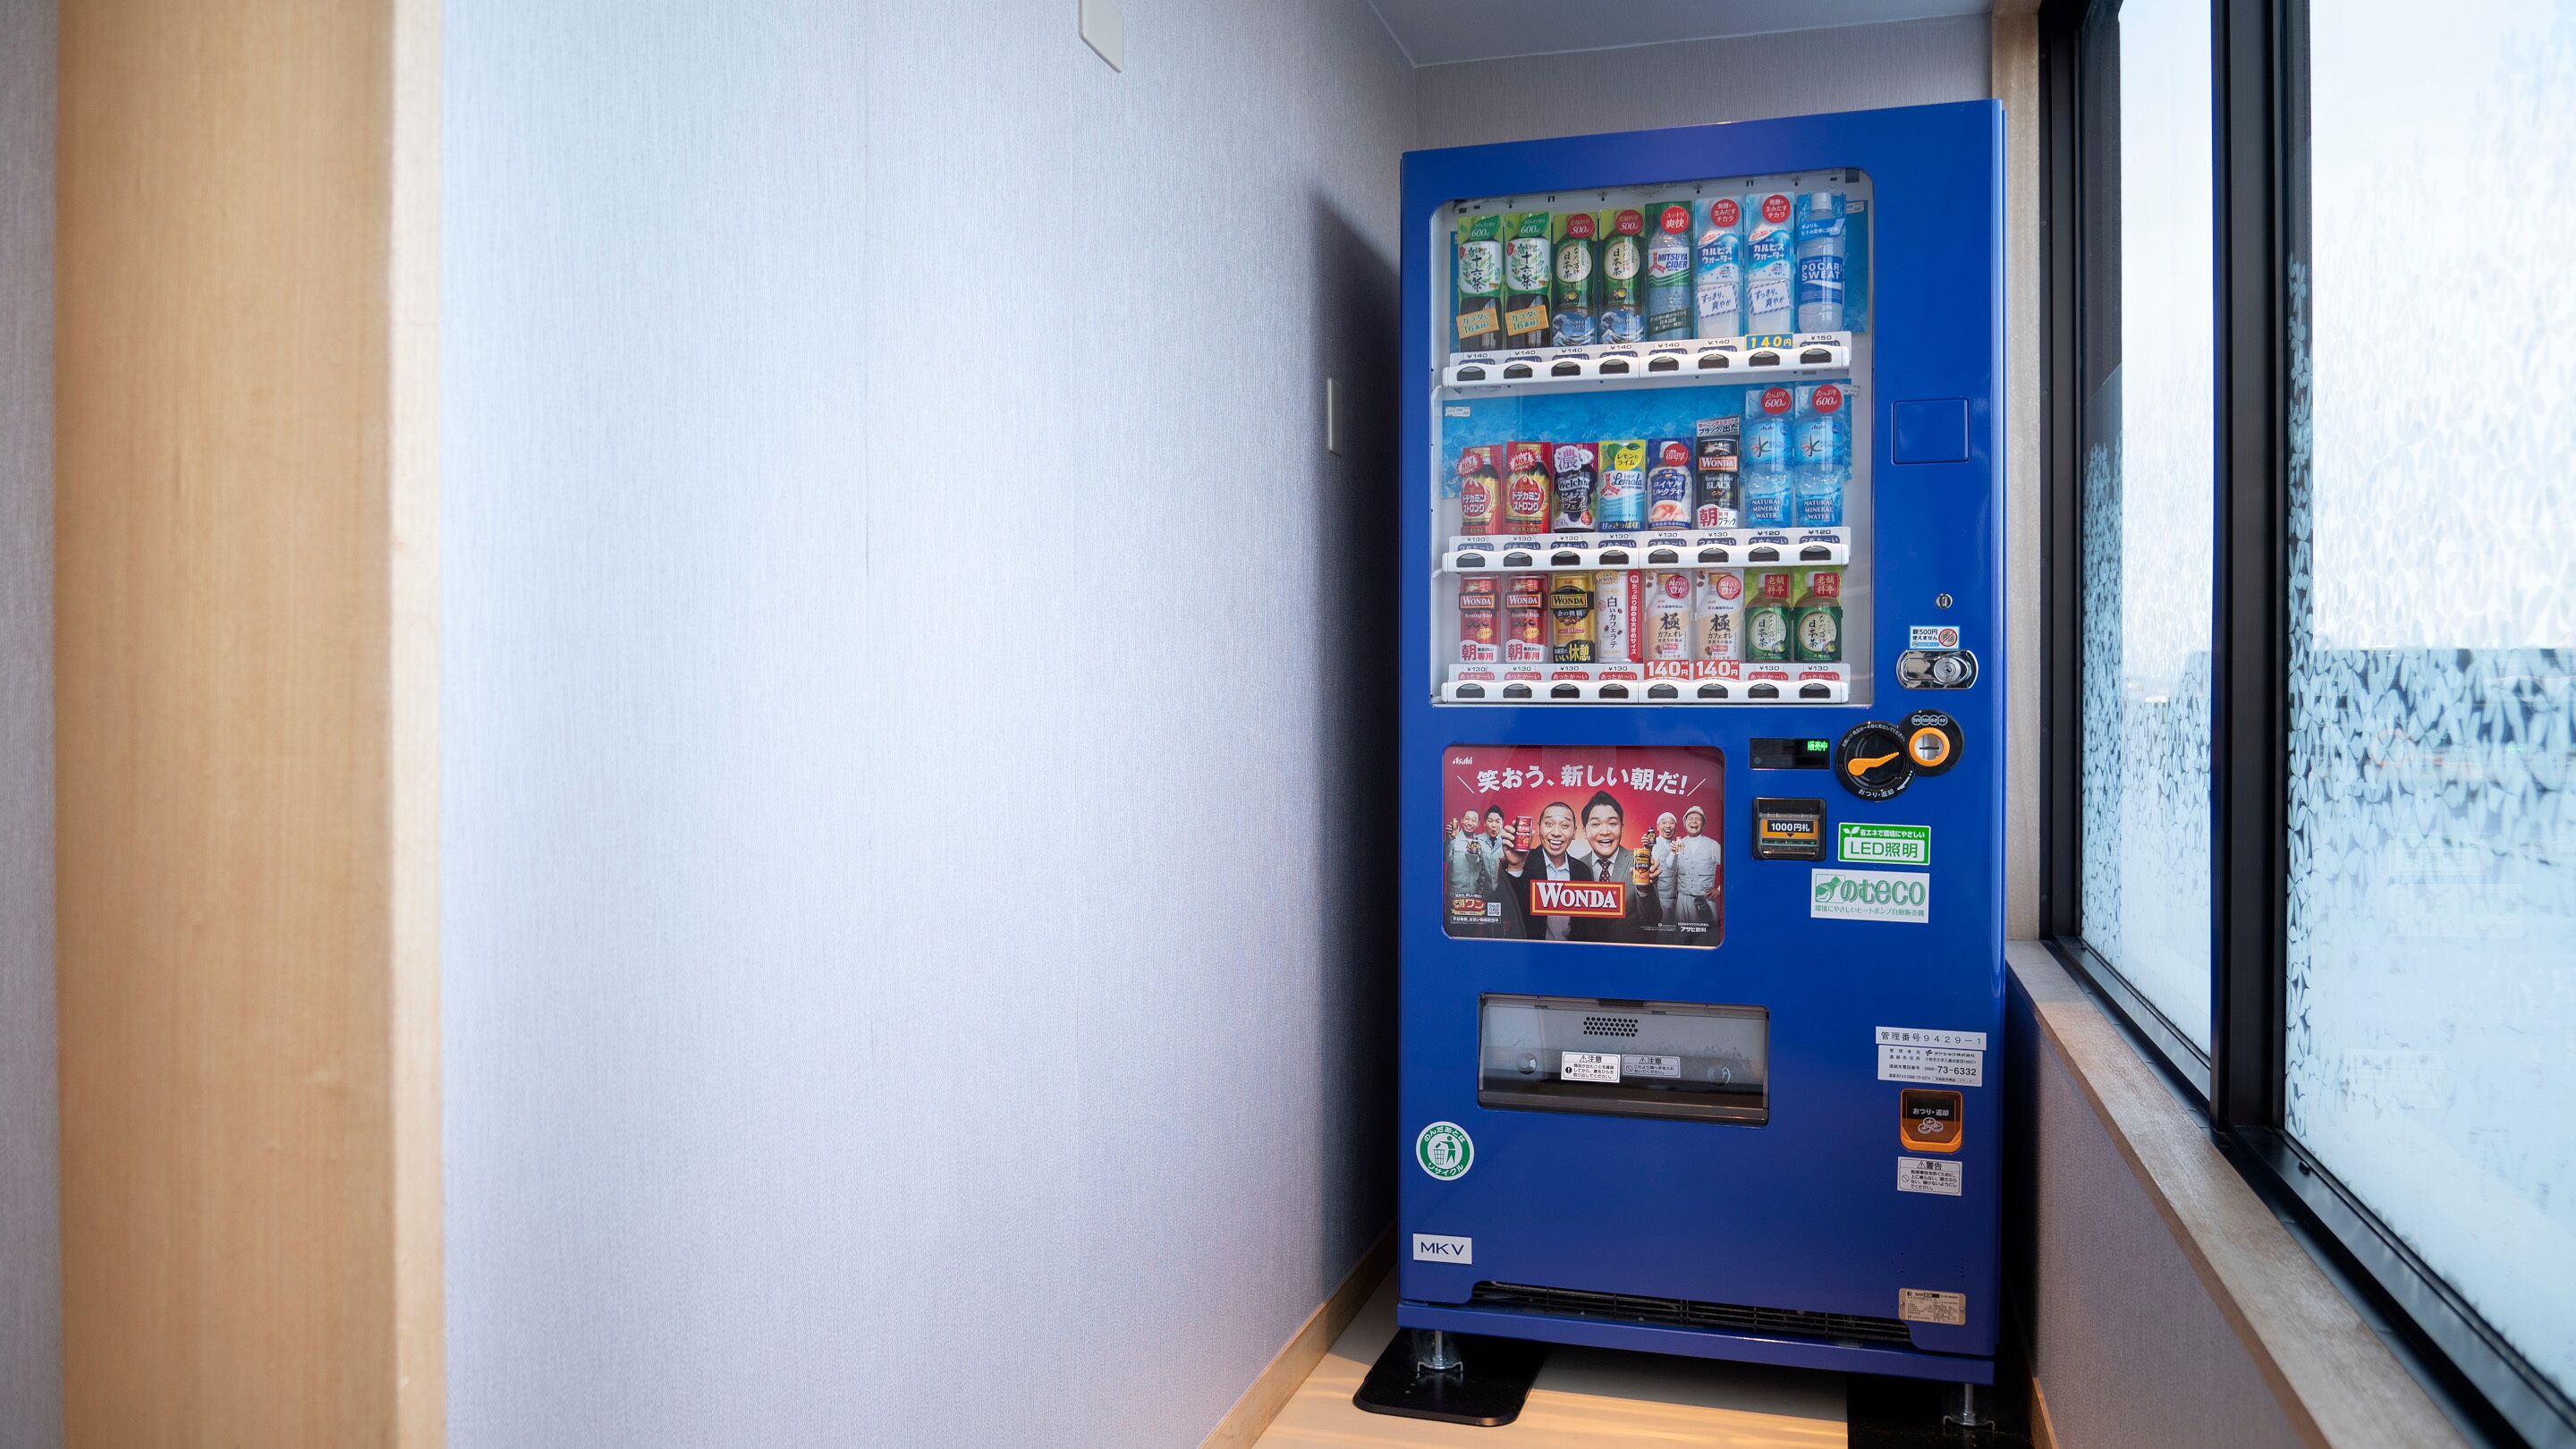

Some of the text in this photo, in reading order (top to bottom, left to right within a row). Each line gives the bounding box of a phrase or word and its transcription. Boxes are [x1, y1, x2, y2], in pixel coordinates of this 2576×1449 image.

[1714, 208, 1735, 216] 生みだす
[1766, 205, 1787, 213] 生みだす
[1665, 218, 1685, 229] 爽快
[1716, 215, 1733, 223] チカラ
[1702, 246, 1733, 256] カルピス
[1753, 243, 1784, 253] カルピス
[1613, 248, 1623, 276] 日本茶
[1657, 252, 1688, 261] MITSUYA
[1563, 251, 1572, 279] 日本茶
[1665, 260, 1688, 269] CIDER
[1801, 261, 1843, 273] POCARI
[1470, 255, 1487, 292] 十六茶
[1521, 251, 1537, 290] 十六茶
[1801, 271, 1840, 282] SWEAT
[1712, 299, 1732, 310] 爽やか
[1765, 296, 1785, 309] 爽やか
[1462, 313, 1489, 325] カラダに
[1511, 310, 1538, 322] カラダに
[1750, 336, 1792, 348] 140円
[1766, 391, 1785, 400] たっぷり
[1817, 389, 1836, 397] たっぷり
[1559, 448, 1589, 470] 濃い
[1702, 457, 1734, 468] WONDA
[1559, 477, 1589, 490] Welch's
[1653, 479, 1682, 488] ロイヤル
[1699, 507, 1718, 528] 朝
[1718, 517, 1736, 526] ブラック
[1767, 576, 1784, 584] 老舗
[1817, 576, 1835, 584] 老舗
[1768, 586, 1784, 595] 料亭
[1817, 586, 1835, 595] 料亭
[1462, 596, 1491, 606] WONDA
[1509, 595, 1538, 606] WONDA
[1554, 597, 1584, 605] WONDA
[1607, 597, 1617, 649] 白いカフェラテ
[1659, 612, 1681, 631] 極
[1709, 614, 1731, 632] 極
[1758, 619, 1768, 648] 日本茶
[1808, 620, 1818, 648] 日本茶
[1462, 644, 1477, 661] 朝
[1477, 652, 1494, 661] 専用
[1508, 643, 1523, 661] 朝
[1523, 651, 1540, 661] 専用
[1647, 661, 1689, 676] 140円
[1696, 661, 1738, 676] 140円
[1807, 741, 1828, 751] 販売中
[1452, 756, 1473, 765] Asahi
[1477, 764, 1688, 796] 笑おう、新しい朝だ!
[1770, 823, 1810, 832] 1000円札
[1860, 829, 1925, 838] 省エネで環境にやさしい
[1850, 841, 1918, 858] LED照明
[1536, 882, 1617, 909] WONDA
[1841, 878, 1926, 906] のむeco
[1453, 898, 1485, 909] 朝ワン
[1814, 904, 1925, 918] 環境にやさしいヒートポンプ自動販売機
[1587, 1055, 1602, 1063] 注意
[1647, 1057, 1662, 1065] 注意
[1912, 1108, 1949, 1116] おつり・返却
[1424, 1126, 1466, 1144] のんだあとは
[1428, 1162, 1464, 1176] リサイクル
[1926, 1161, 1942, 1171] 警告
[1420, 1241, 1464, 1256] MKV
